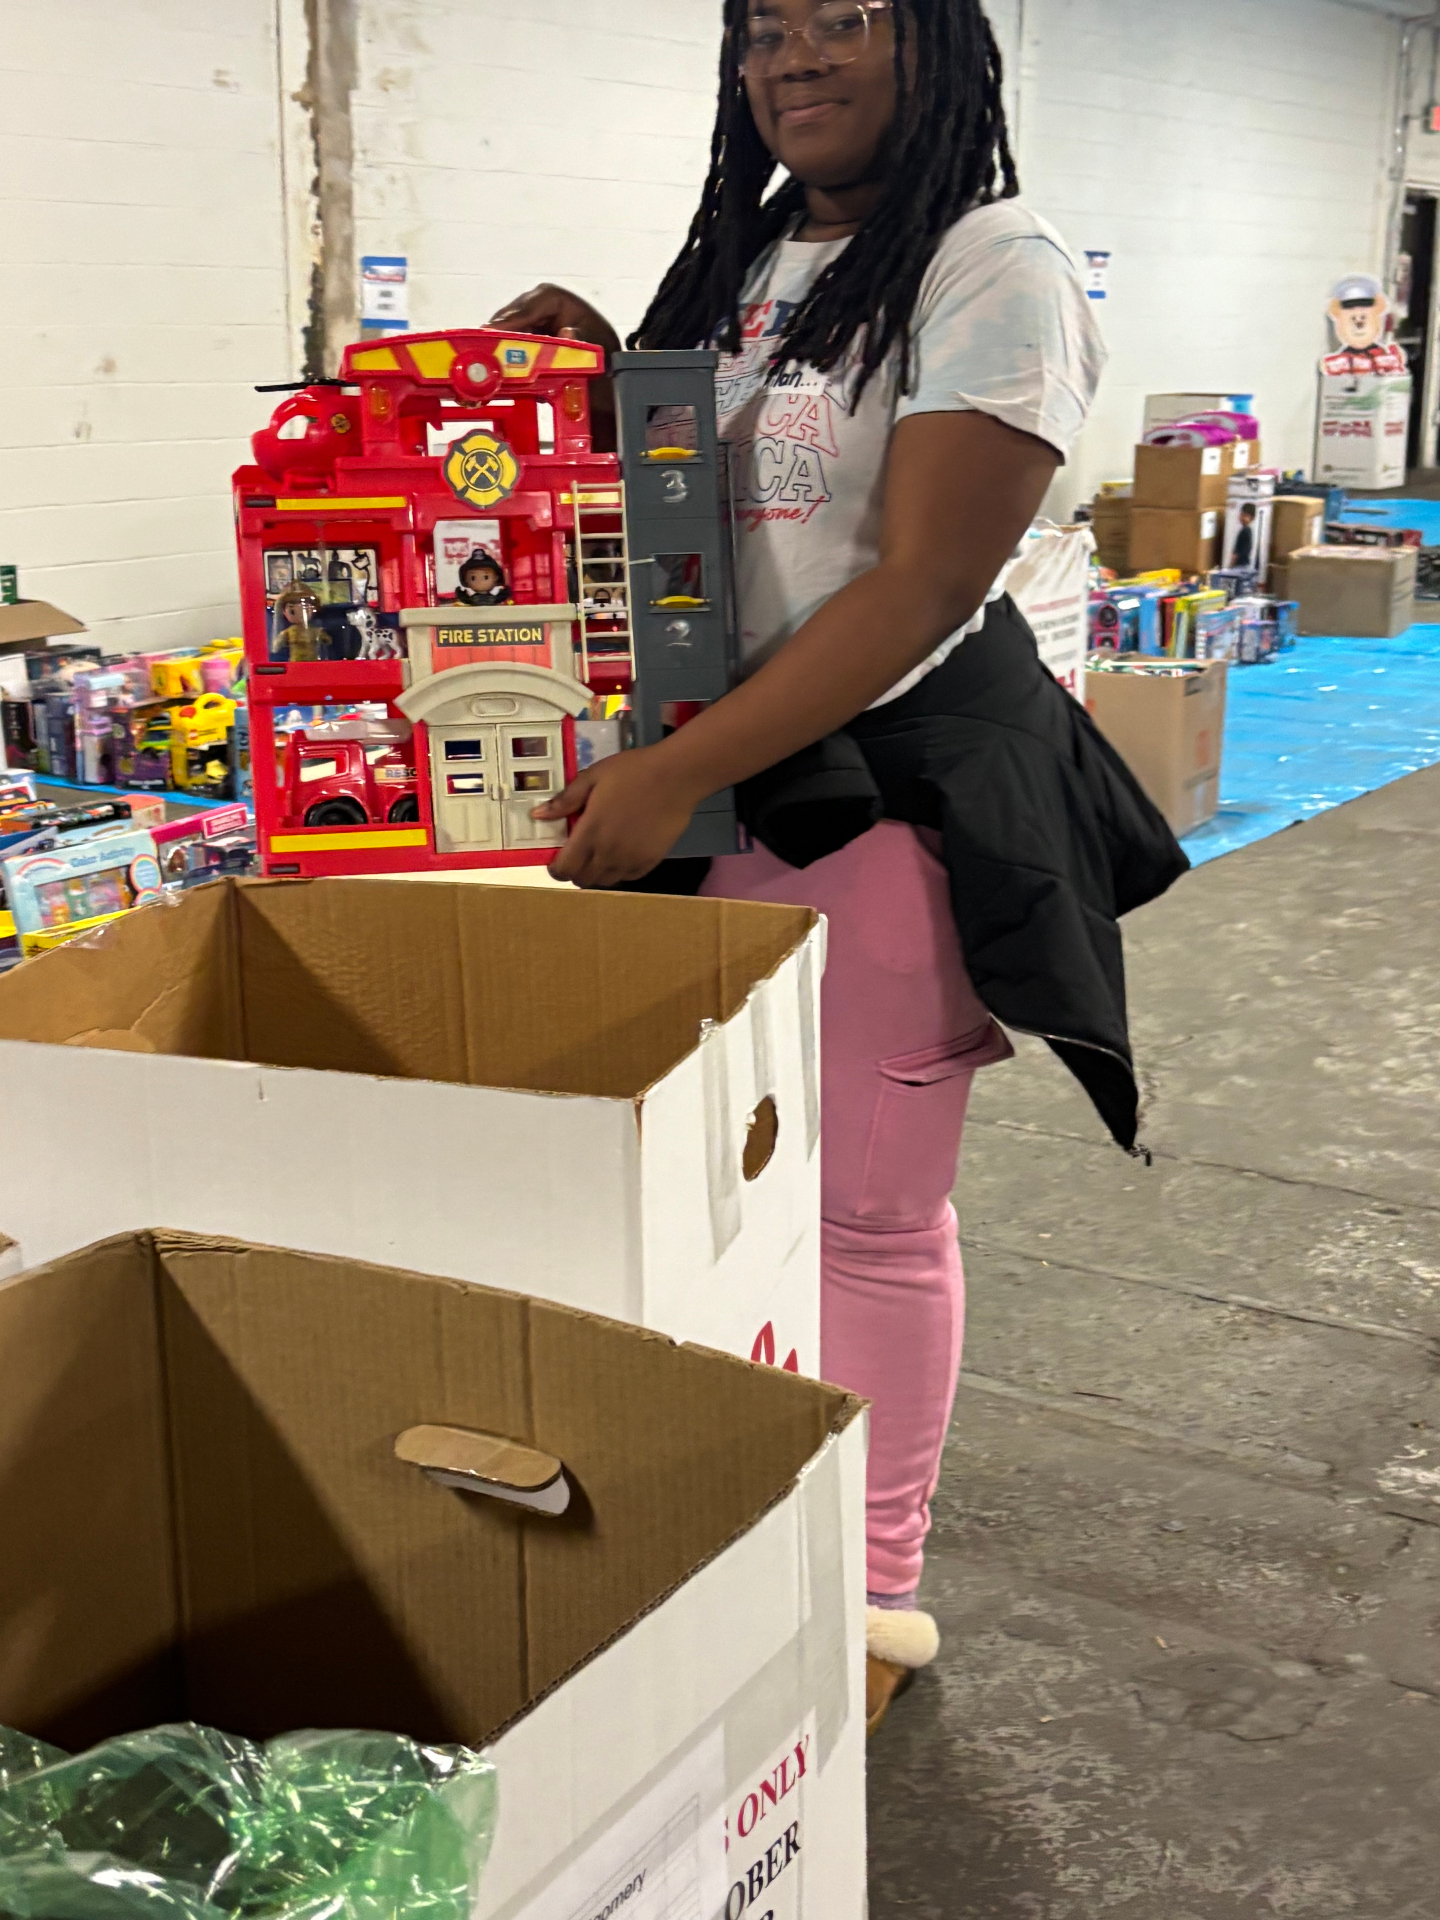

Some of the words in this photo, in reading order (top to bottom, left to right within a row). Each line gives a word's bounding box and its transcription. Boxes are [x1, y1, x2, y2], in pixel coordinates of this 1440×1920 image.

[660, 469, 689, 504] 3
[438, 629, 474, 644] FIRE
[477, 627, 543, 643] STATION
[664, 619, 694, 647] 2
[737, 1734, 810, 1838] ONLY
[724, 1820, 802, 1920] OBER
[588, 1868, 648, 1920] omery
